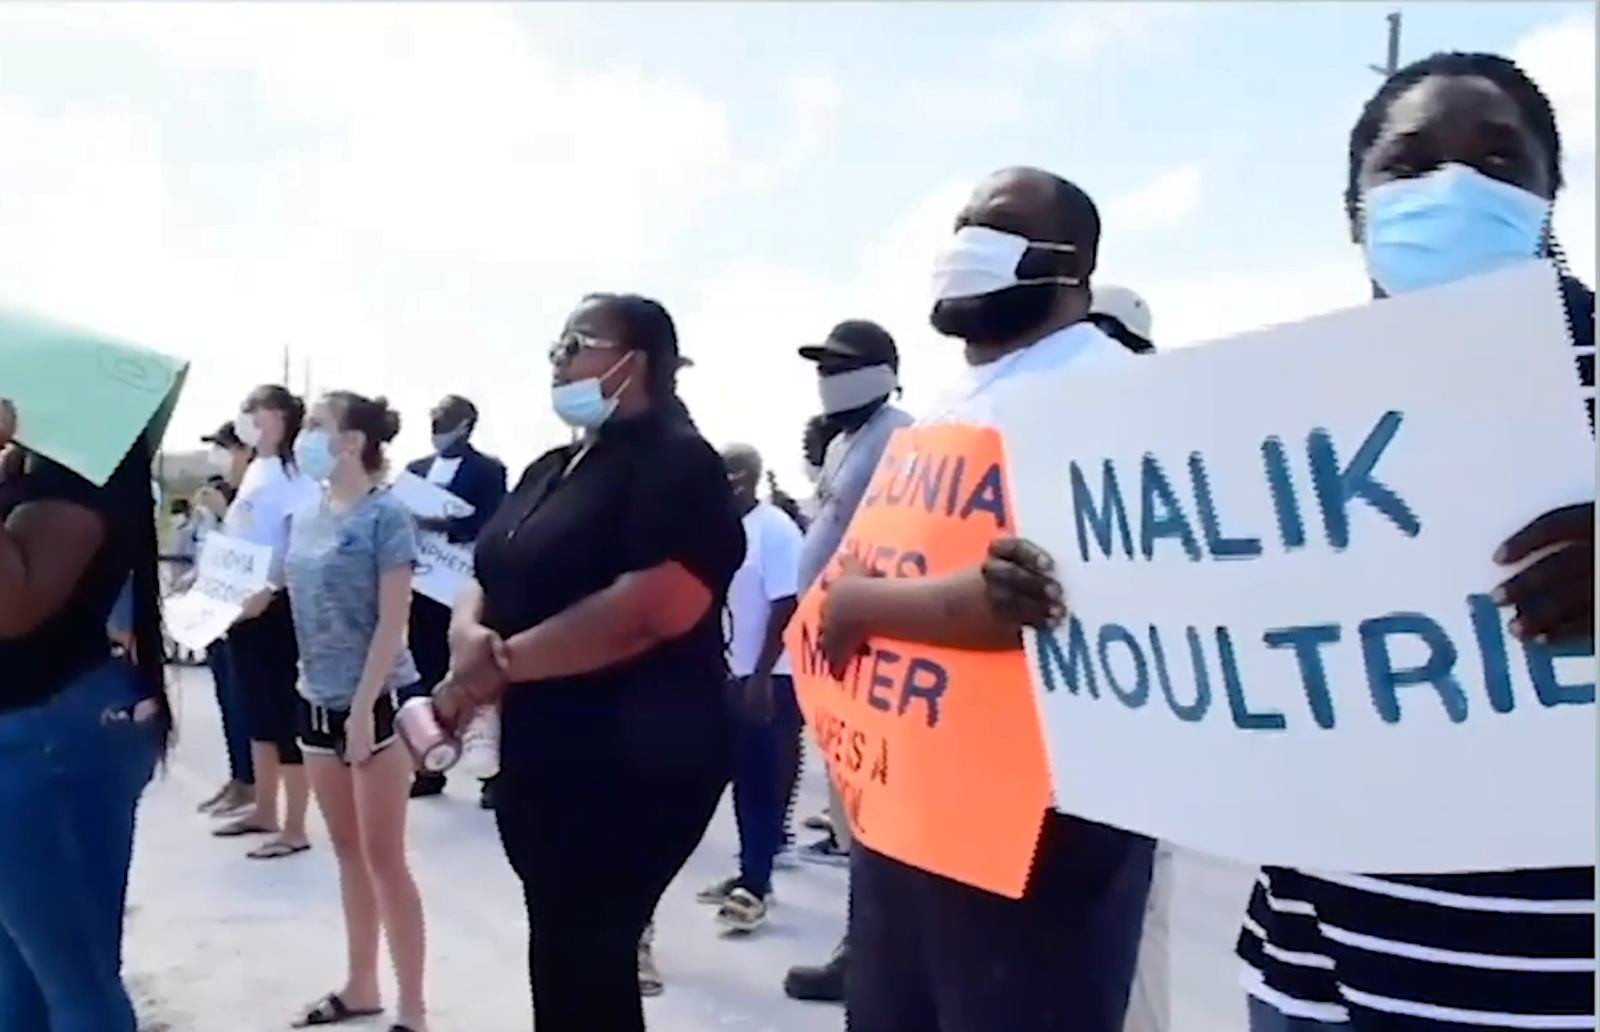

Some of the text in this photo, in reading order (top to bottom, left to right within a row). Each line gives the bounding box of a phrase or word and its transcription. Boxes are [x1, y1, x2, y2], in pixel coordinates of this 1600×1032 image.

[1069, 410, 1421, 562] MALIK
[801, 620, 948, 729] MTER
[1035, 593, 1595, 730] MOULTRIE
[870, 737, 889, 786] A
